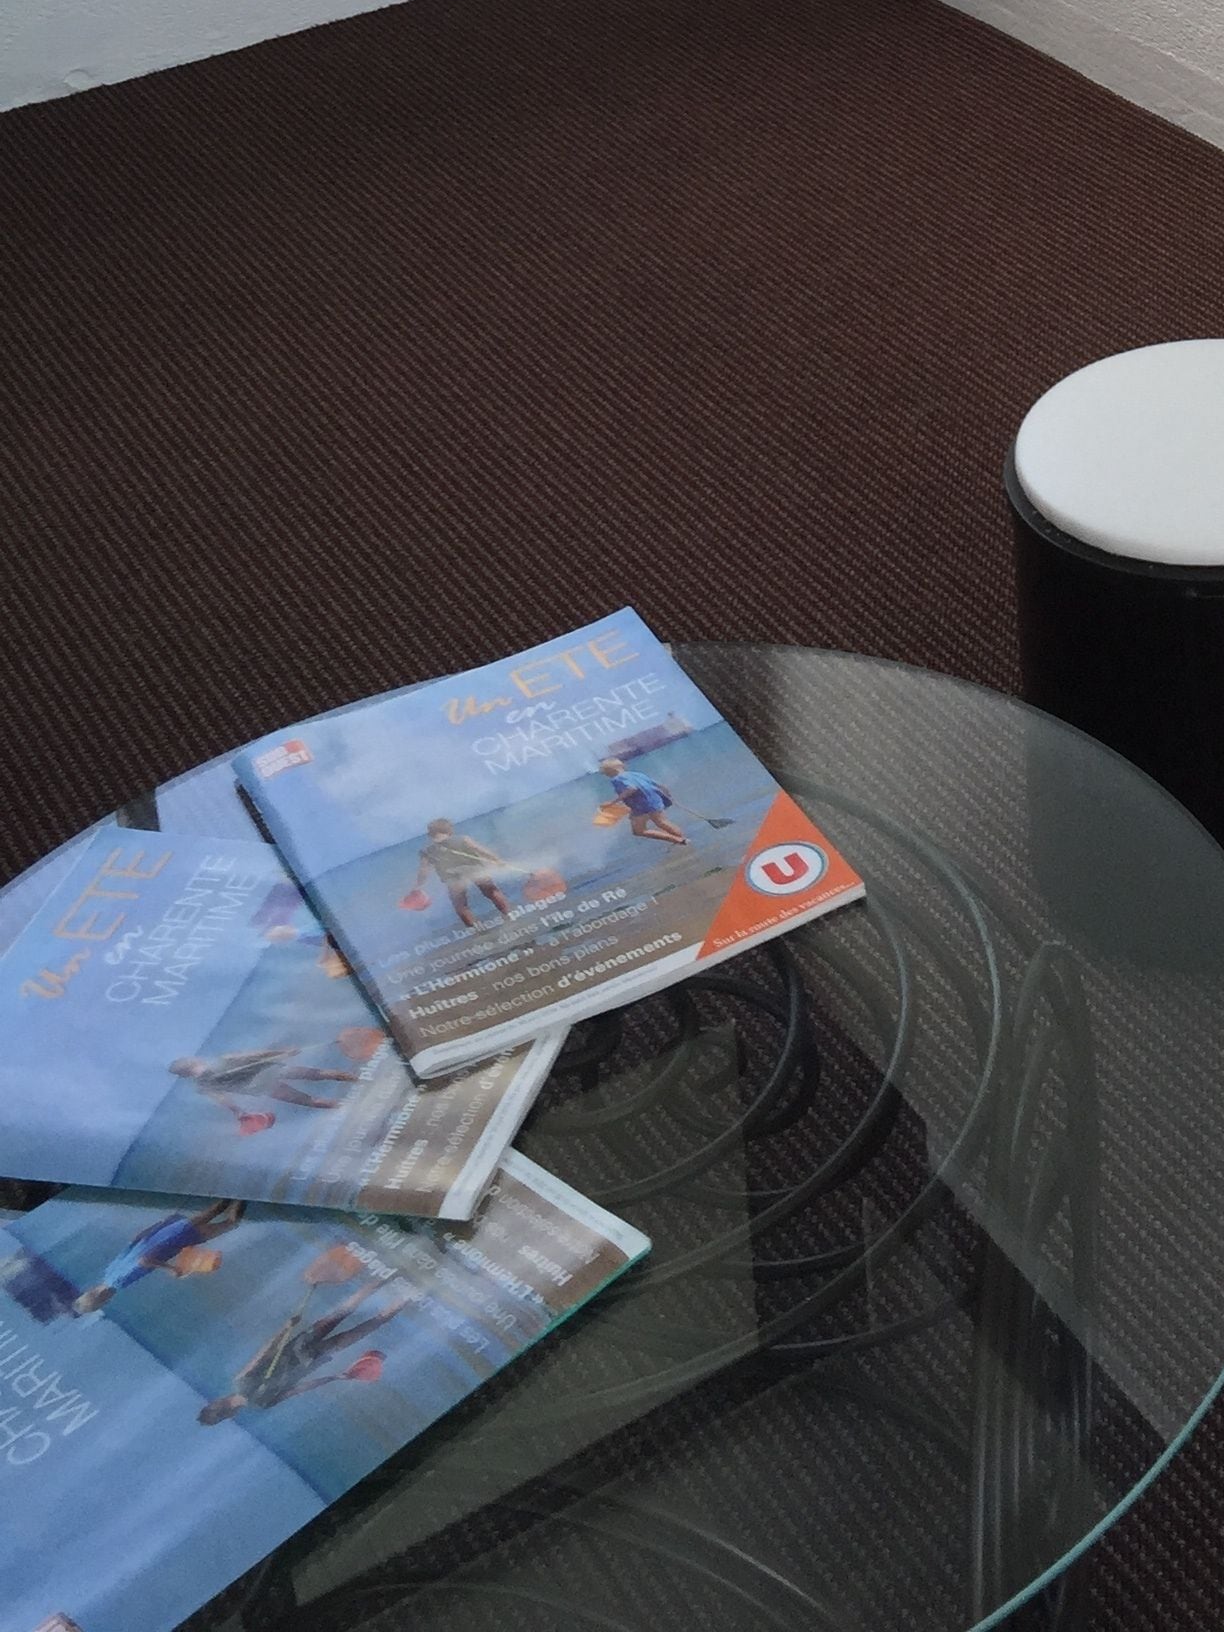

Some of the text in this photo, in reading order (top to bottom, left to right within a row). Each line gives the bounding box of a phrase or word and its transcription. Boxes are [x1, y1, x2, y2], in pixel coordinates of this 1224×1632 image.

[443, 694, 512, 726] Un
[471, 672, 668, 756] CHARENTE
[484, 701, 660, 776] MARITIME
[505, 700, 557, 725] en
[761, 851, 810, 886] U
[104, 854, 239, 1003] CHARENTE
[140, 873, 263, 1006] MARITIME
[388, 962, 426, 986] Une
[429, 939, 495, 972] journée
[498, 923, 540, 947] dans
[576, 896, 600, 914] de
[601, 885, 627, 905] Ré
[413, 951, 521, 998] L'Hermione
[561, 900, 651, 945] l'abordage
[415, 933, 452, 957] plus
[453, 916, 505, 942] belles
[507, 890, 567, 922] plages
[713, 931, 737, 949] Sur
[736, 924, 751, 939] la
[750, 915, 779, 935] route
[778, 906, 800, 921] des
[19, 946, 92, 1000] Un
[407, 933, 620, 1021] Huîtres nos bons plans
[556, 930, 685, 991] d'événements
[344, 1240, 400, 1281] plages
